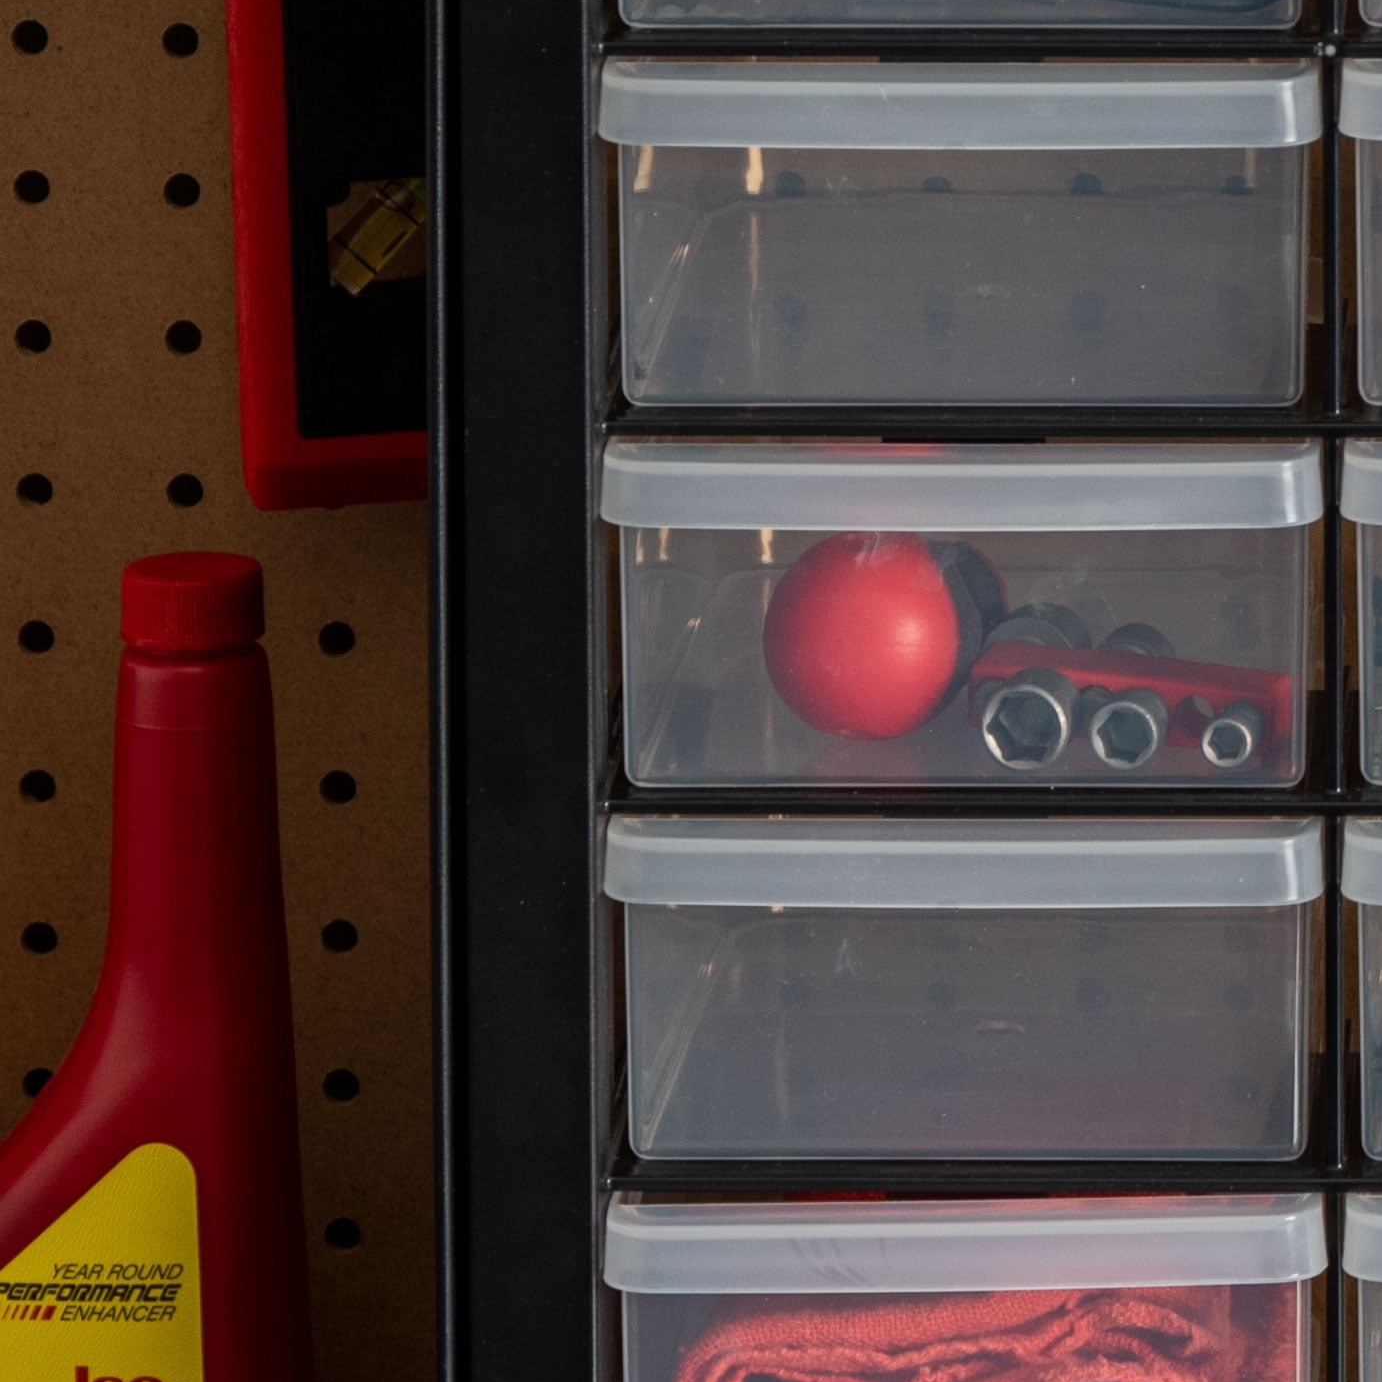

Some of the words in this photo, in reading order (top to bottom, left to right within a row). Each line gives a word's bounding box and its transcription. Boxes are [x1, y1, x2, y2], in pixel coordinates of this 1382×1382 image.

[51, 1263, 104, 1280] YEAR
[106, 1263, 185, 1281] ROUND
[60, 1304, 177, 1322] ENHANCER
